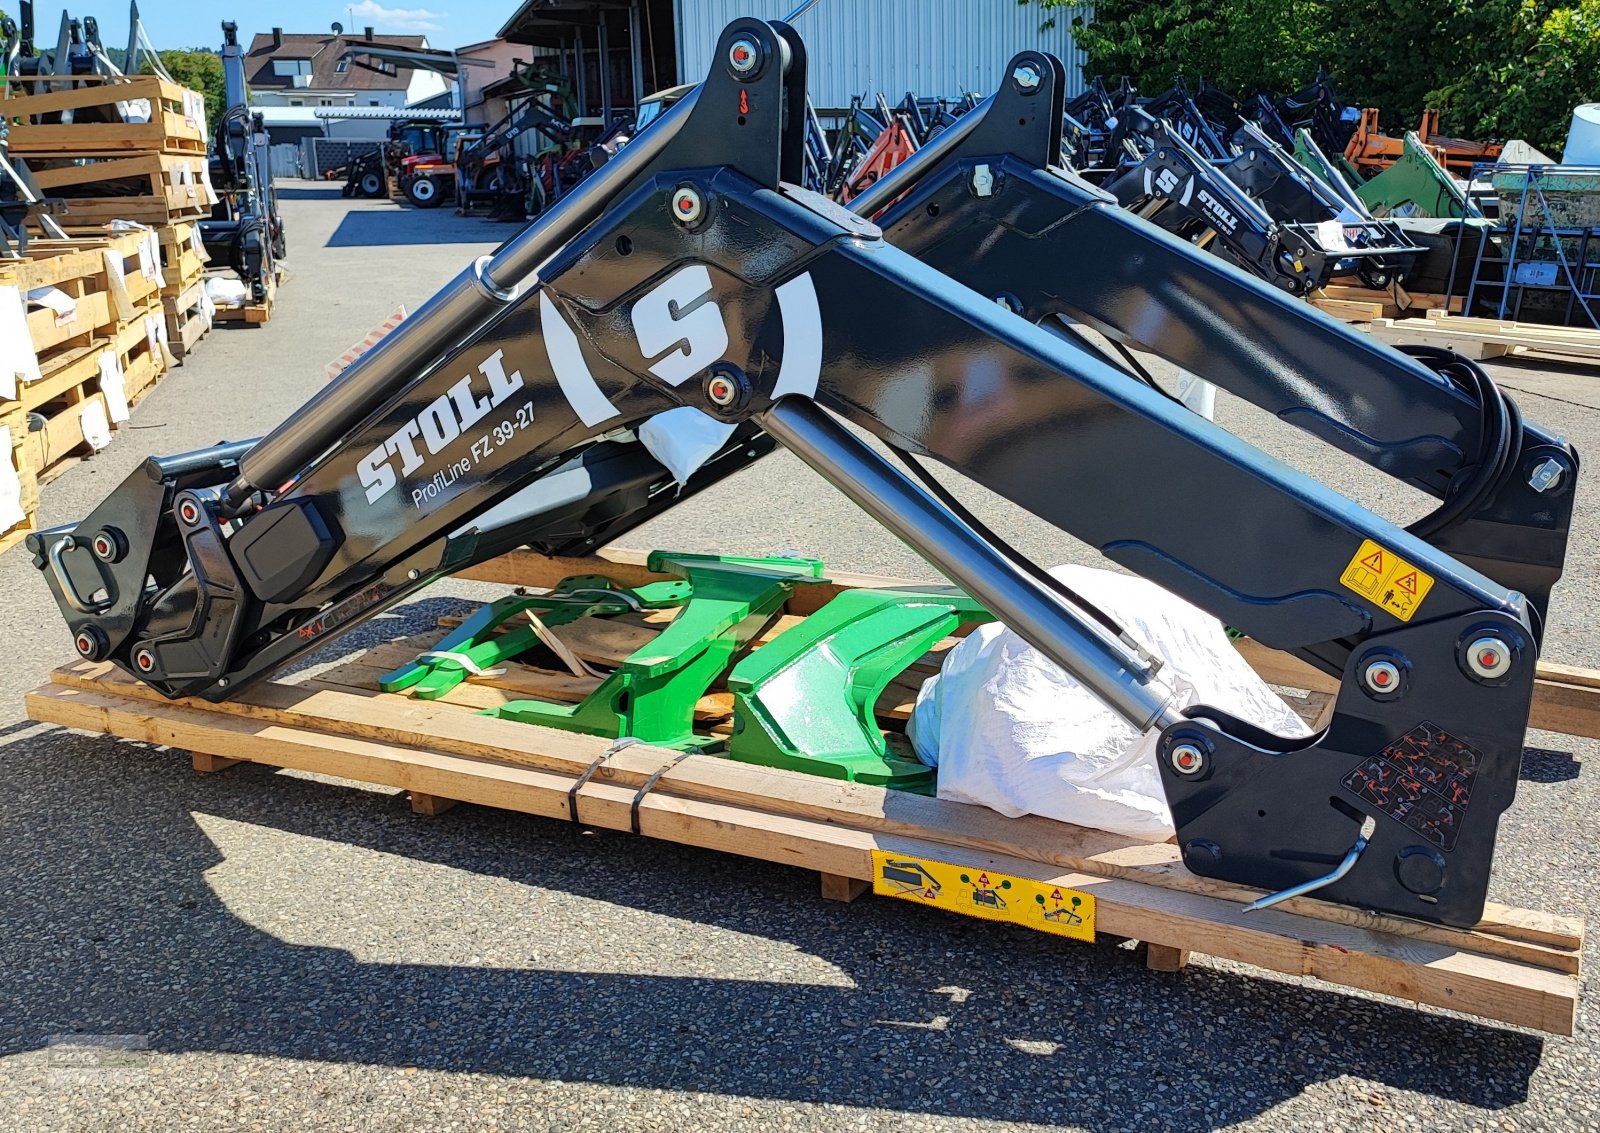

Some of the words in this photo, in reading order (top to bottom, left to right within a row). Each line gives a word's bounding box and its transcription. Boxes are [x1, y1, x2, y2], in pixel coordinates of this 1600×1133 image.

[505, 127, 520, 139] U10
[1155, 168, 1180, 194] S
[1197, 189, 1238, 230] STOLL
[631, 265, 729, 387] S
[356, 348, 525, 506] STOLL
[411, 457, 471, 509] ProfiLine
[470, 434, 494, 464] FZ
[492, 401, 535, 446] 39-27
